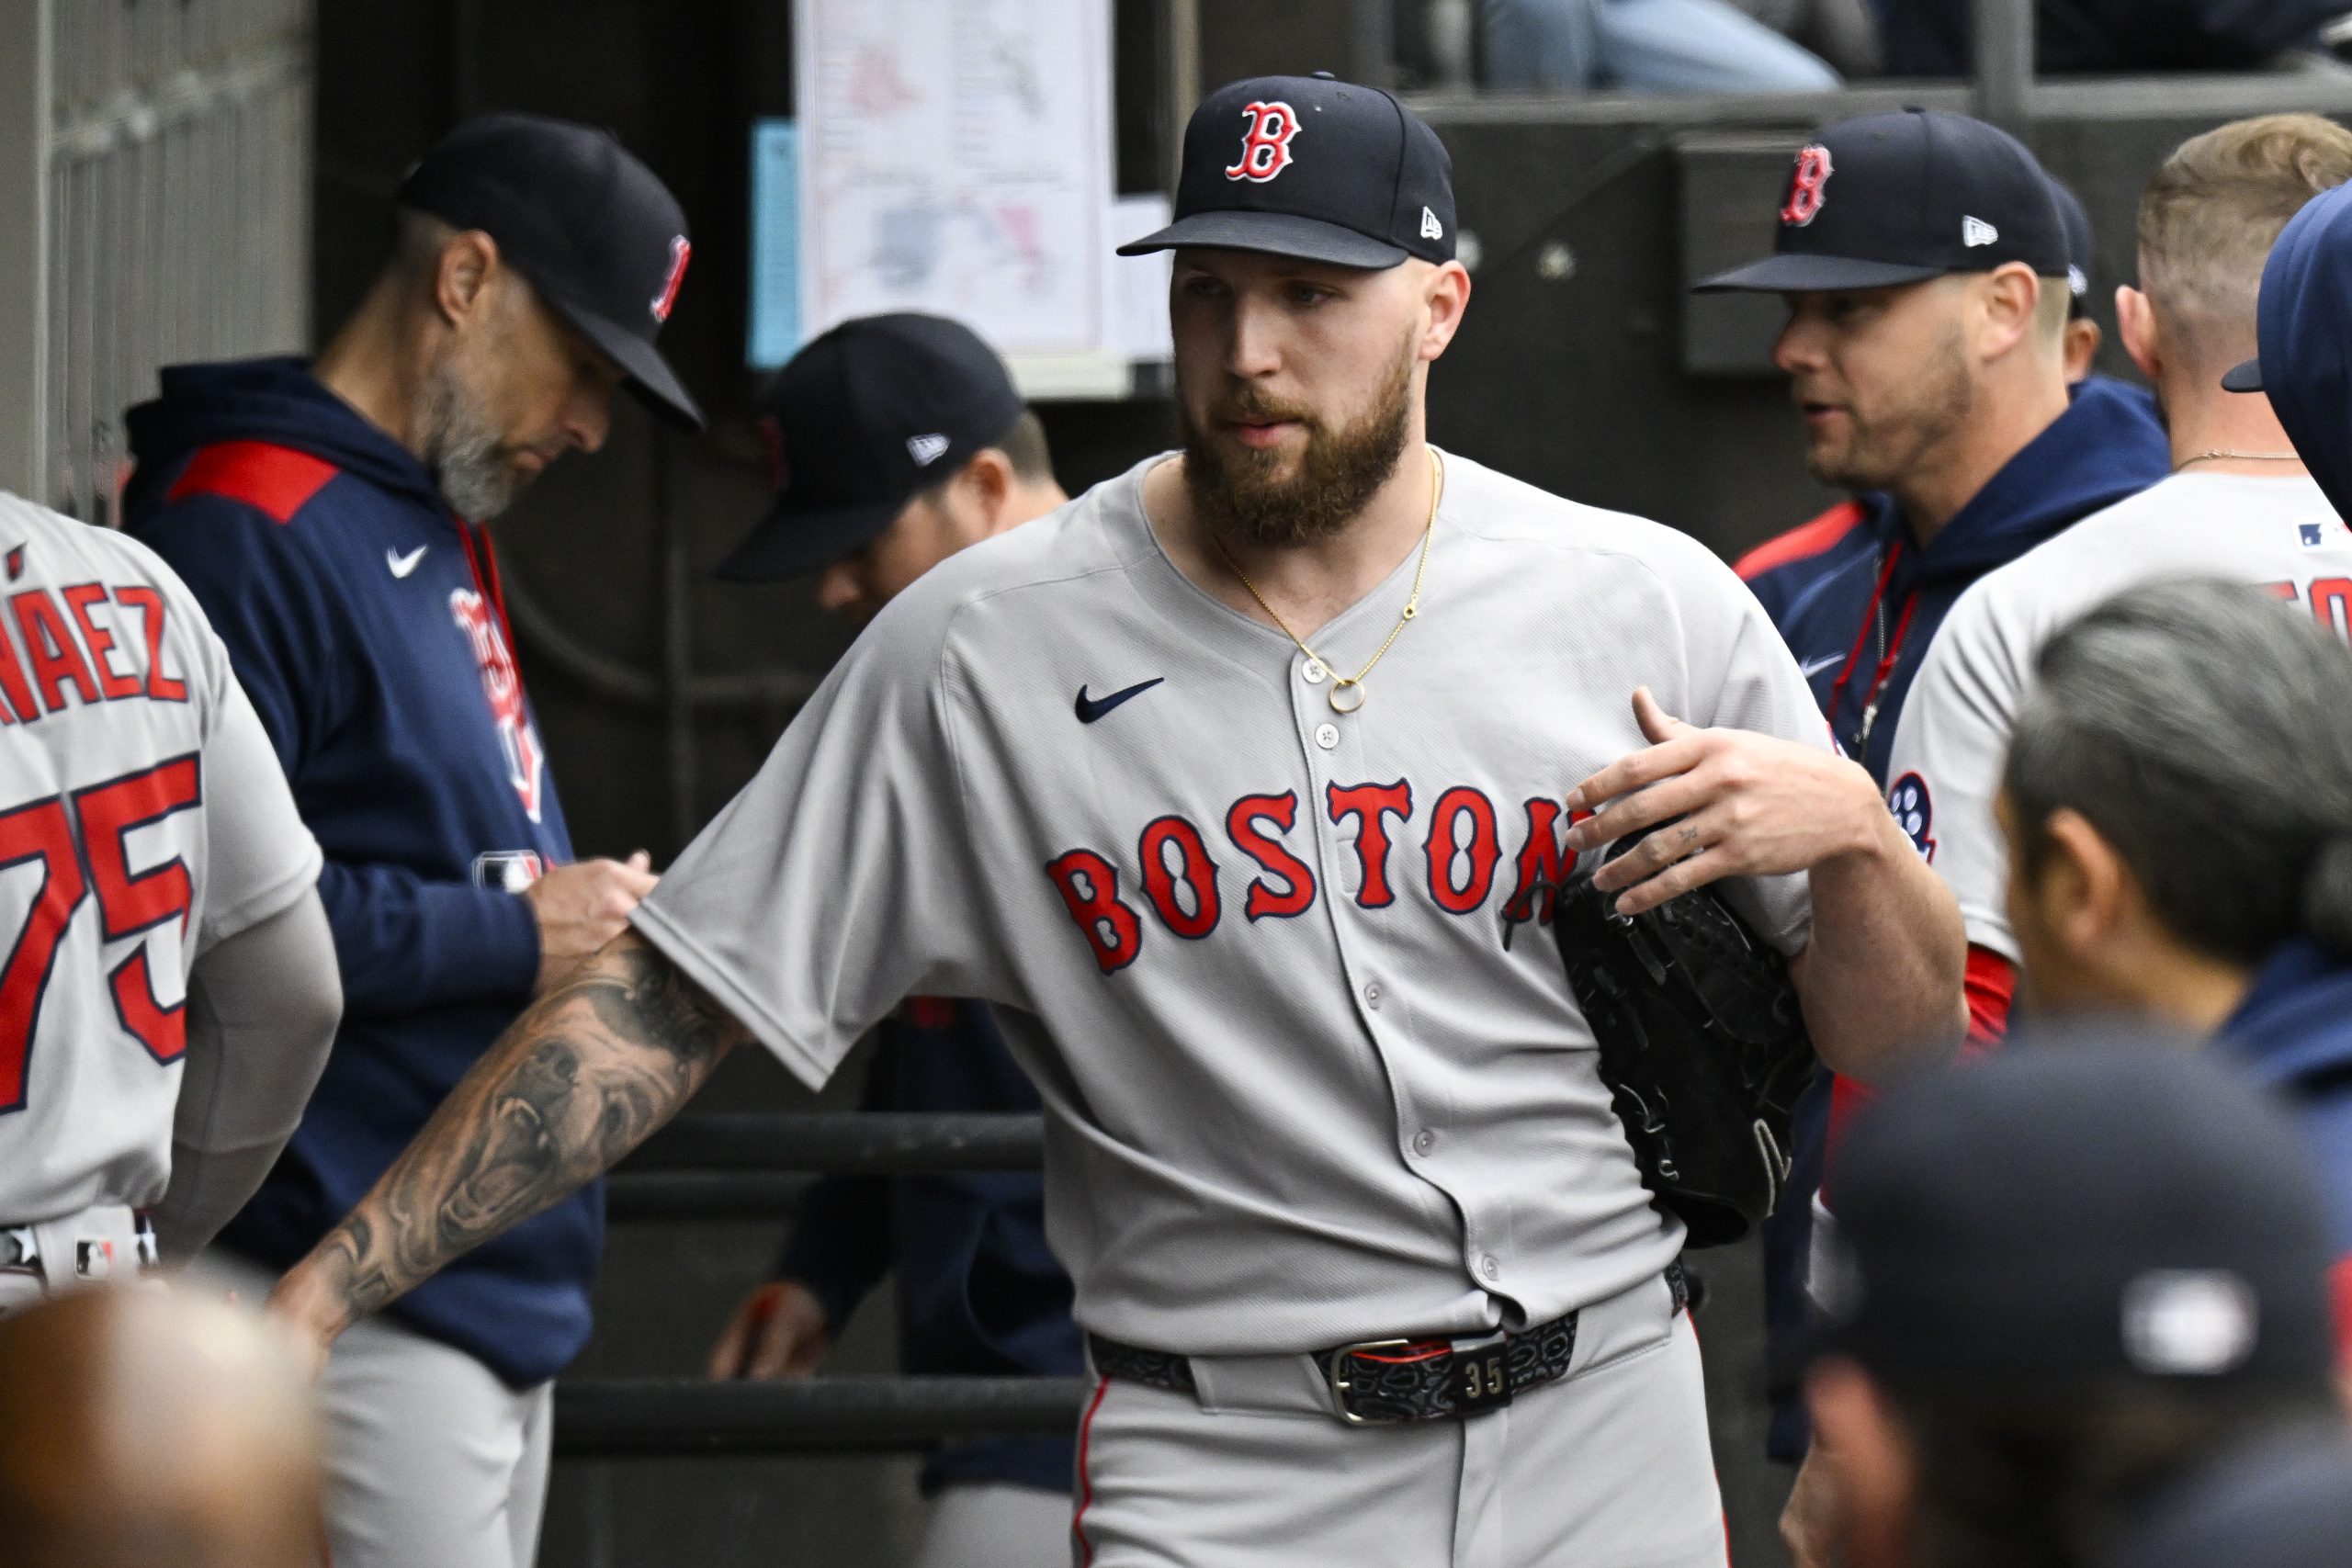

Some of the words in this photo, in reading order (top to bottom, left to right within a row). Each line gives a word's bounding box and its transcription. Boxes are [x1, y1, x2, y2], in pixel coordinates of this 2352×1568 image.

[1225, 101, 1301, 183] B
[0, 750, 202, 1116] 75
[1046, 778, 1598, 976] BOSTON
[1464, 1357, 1502, 1399] 35
